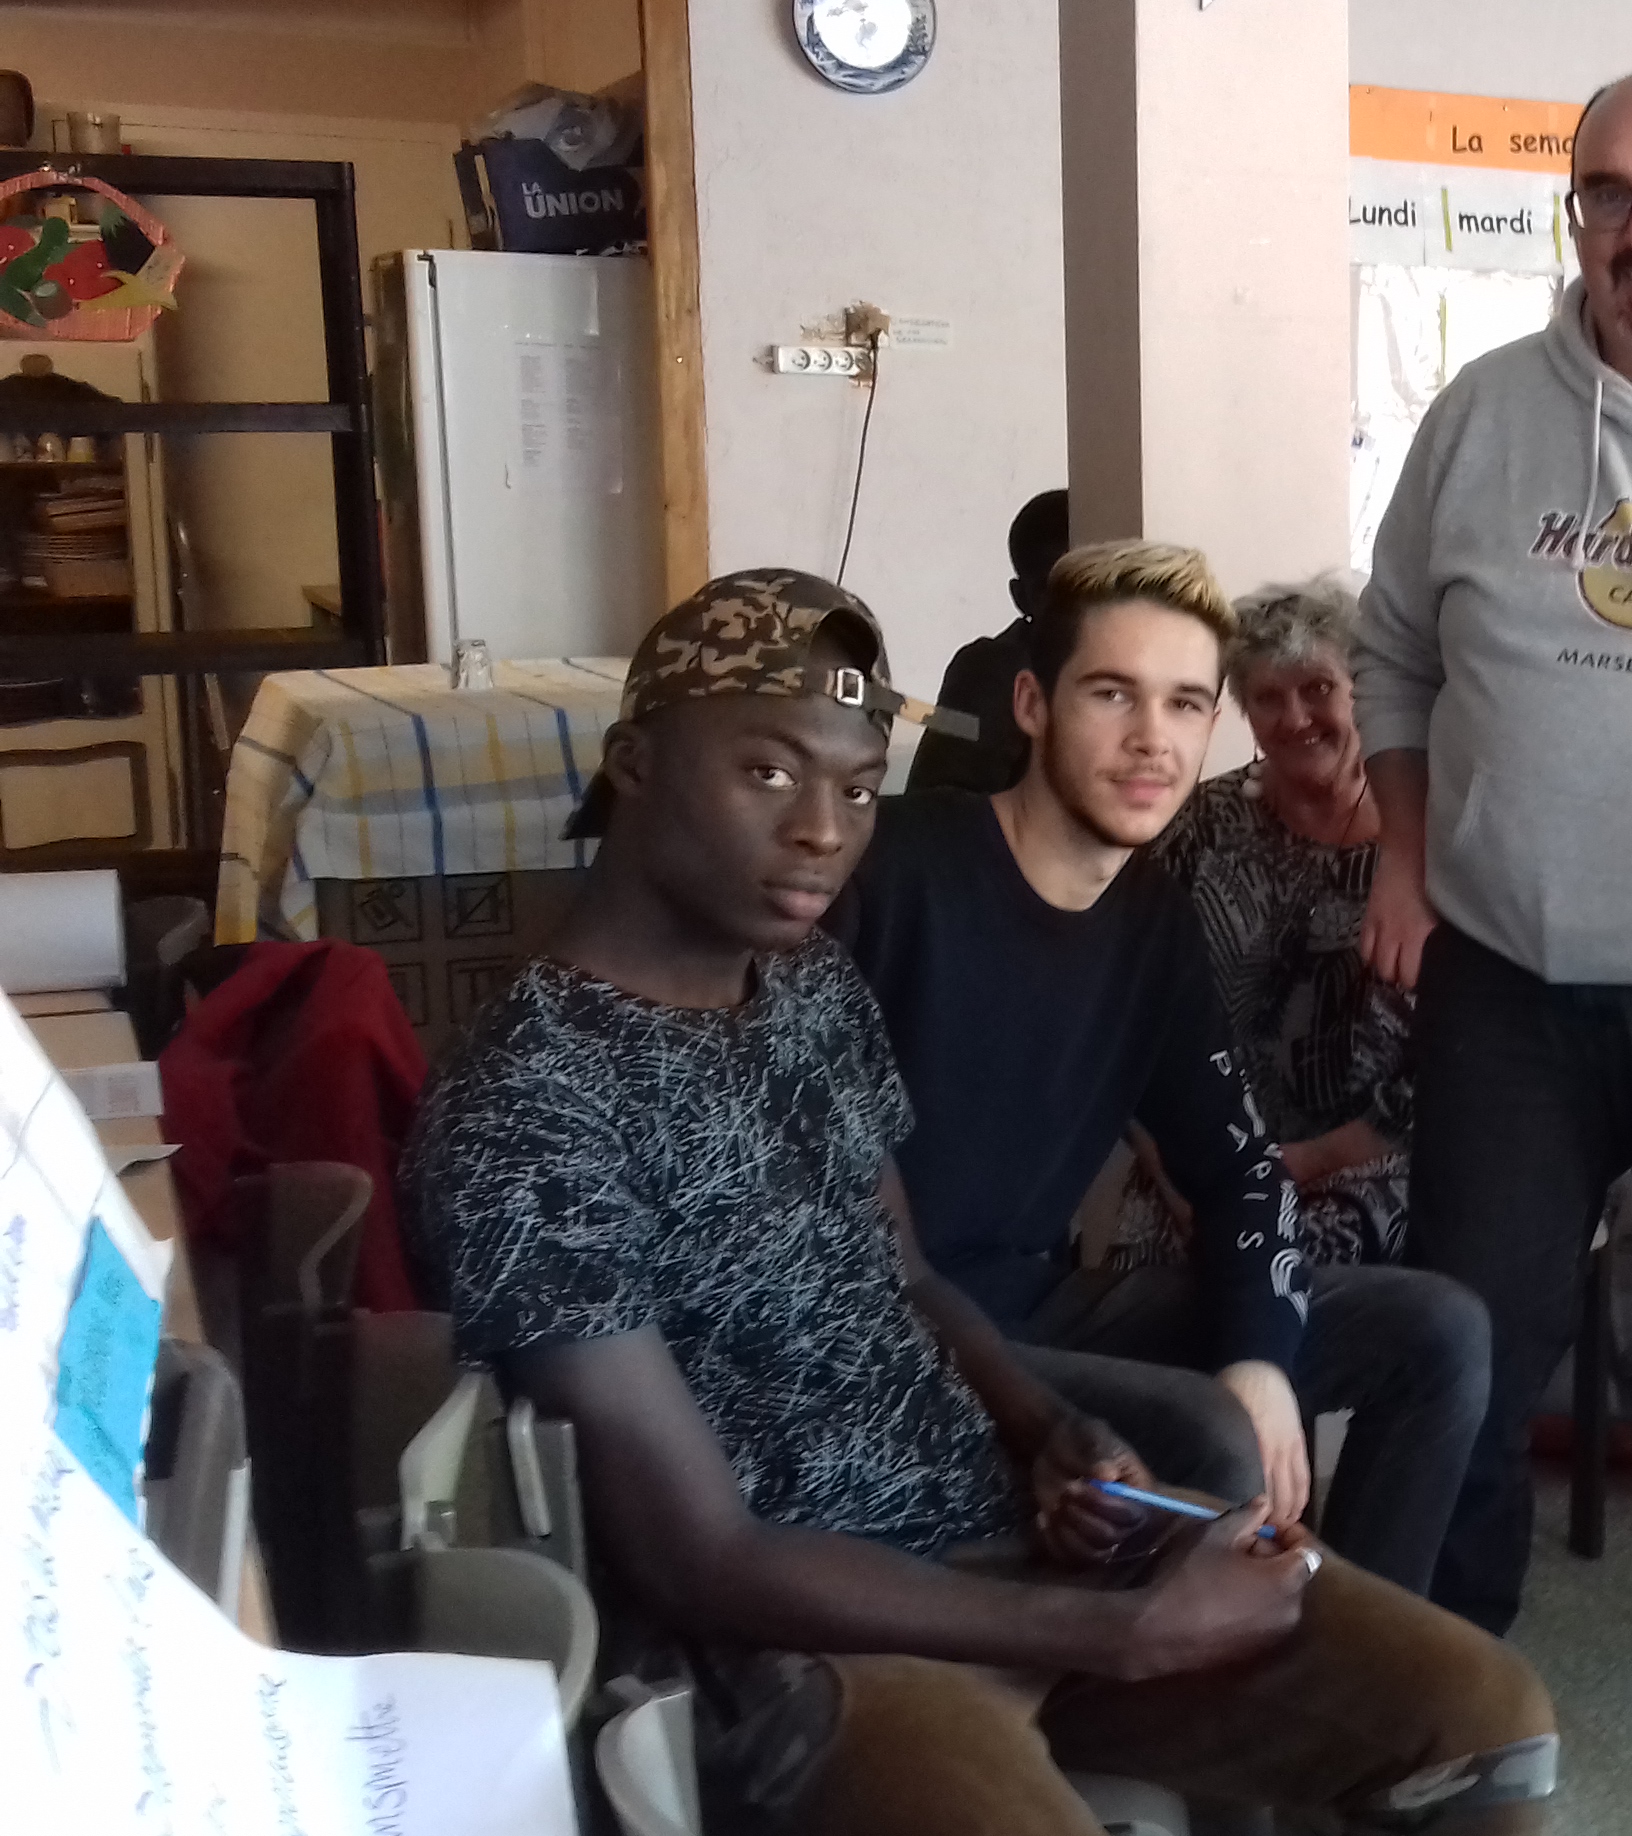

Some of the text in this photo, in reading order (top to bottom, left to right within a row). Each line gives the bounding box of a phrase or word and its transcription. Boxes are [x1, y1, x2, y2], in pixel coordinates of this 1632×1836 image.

[1451, 124, 1484, 154] La
[522, 182, 541, 195] LA
[523, 188, 624, 219] UNION
[1458, 208, 1533, 235] mardi
